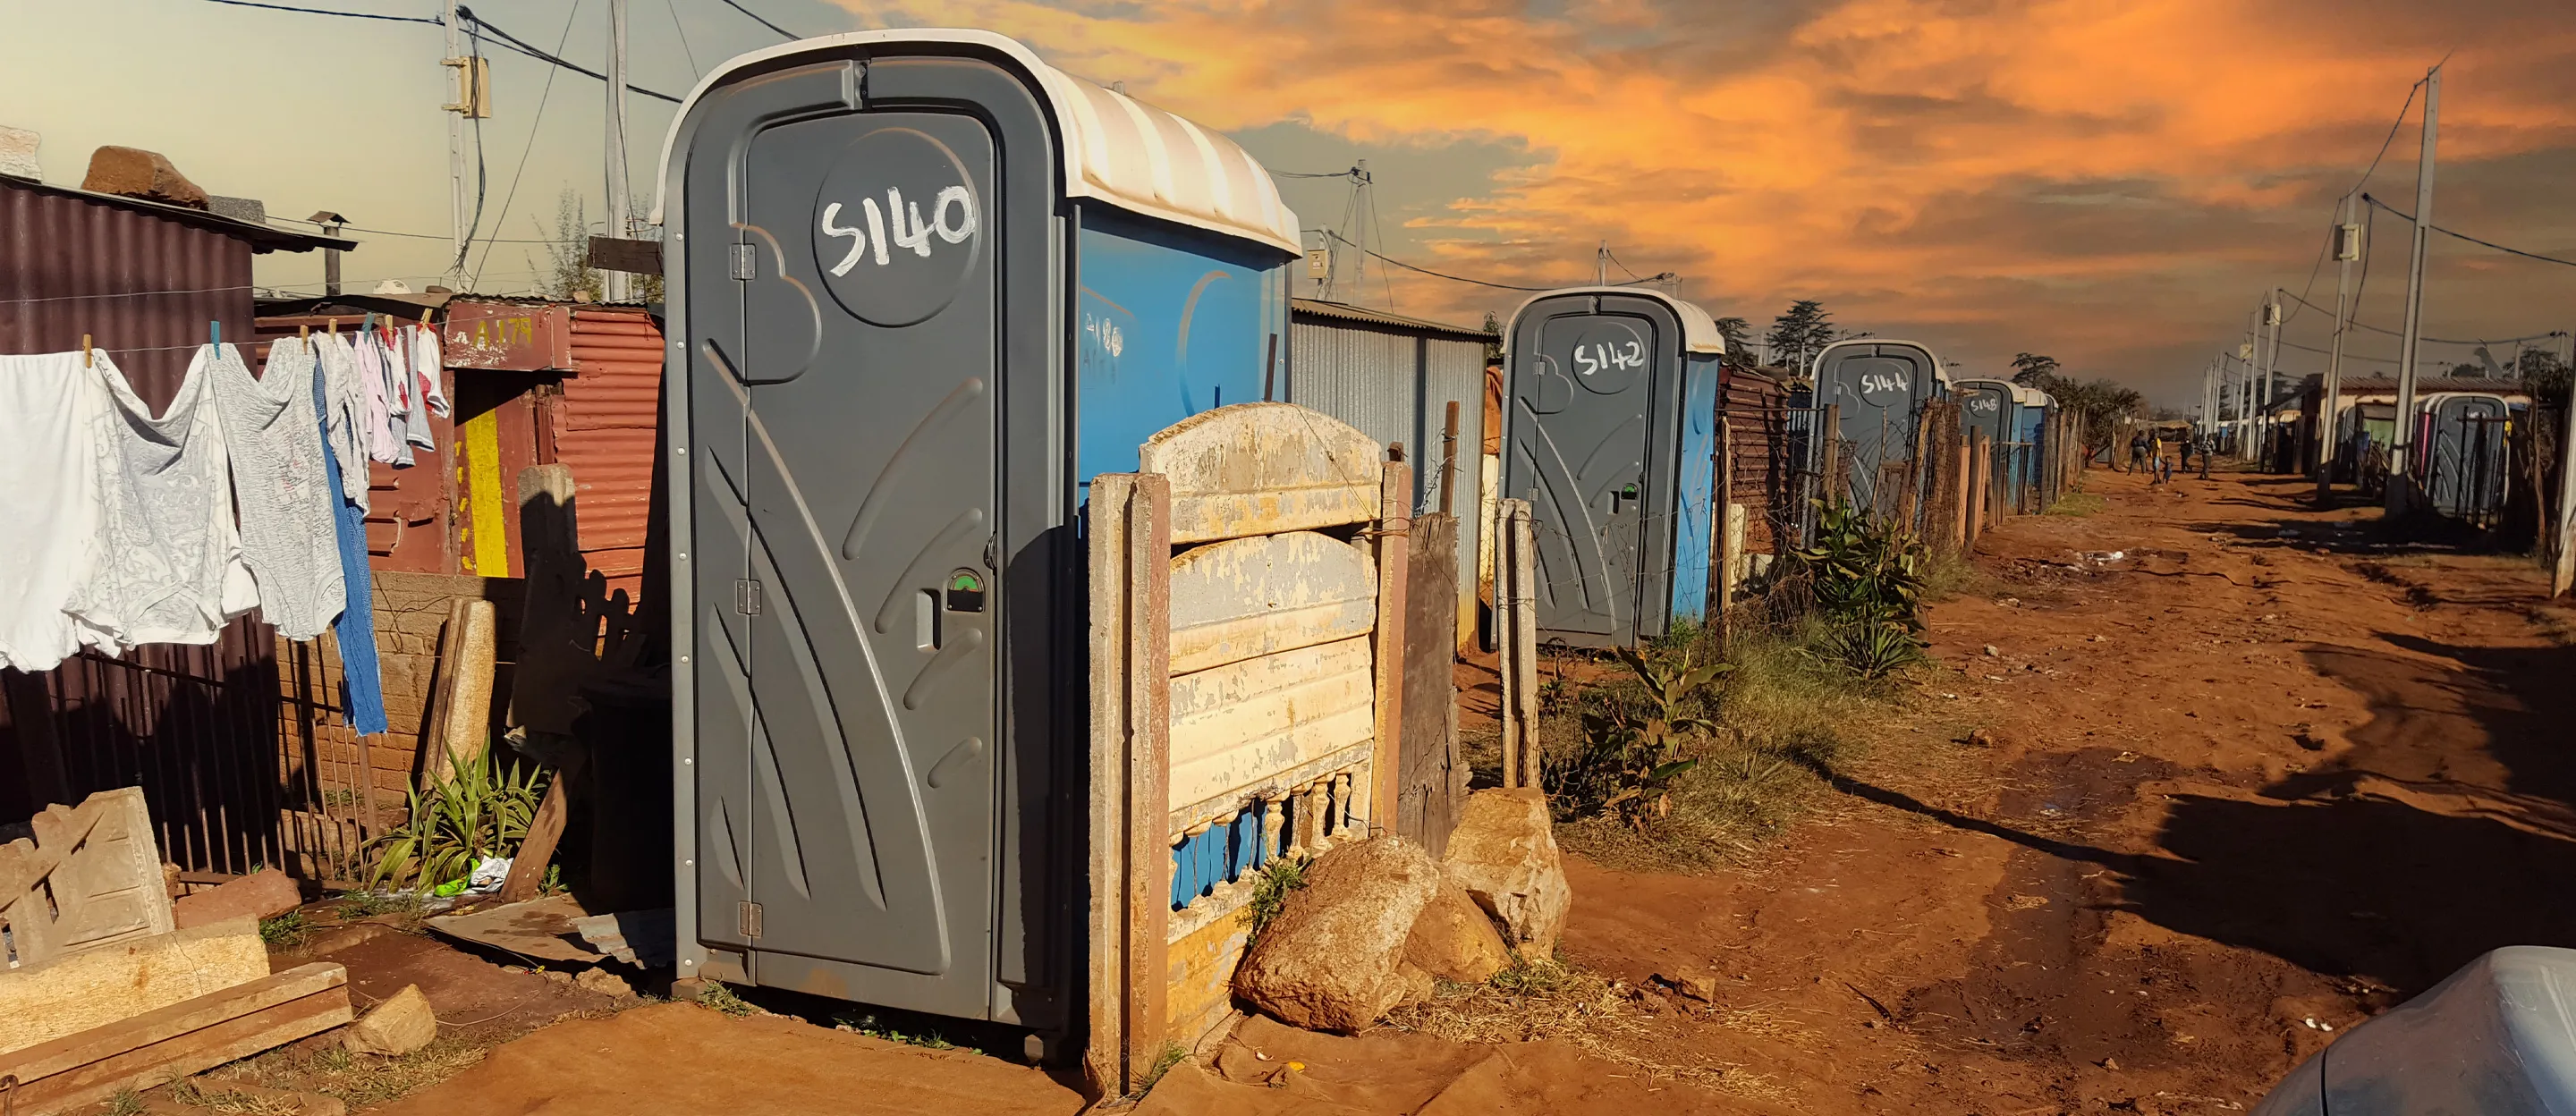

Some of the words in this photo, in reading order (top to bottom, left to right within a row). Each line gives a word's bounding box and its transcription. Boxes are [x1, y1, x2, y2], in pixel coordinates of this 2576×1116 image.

[822, 186, 976, 277] S140
[1574, 342, 1643, 376] S142
[1860, 372, 1908, 394] S144
